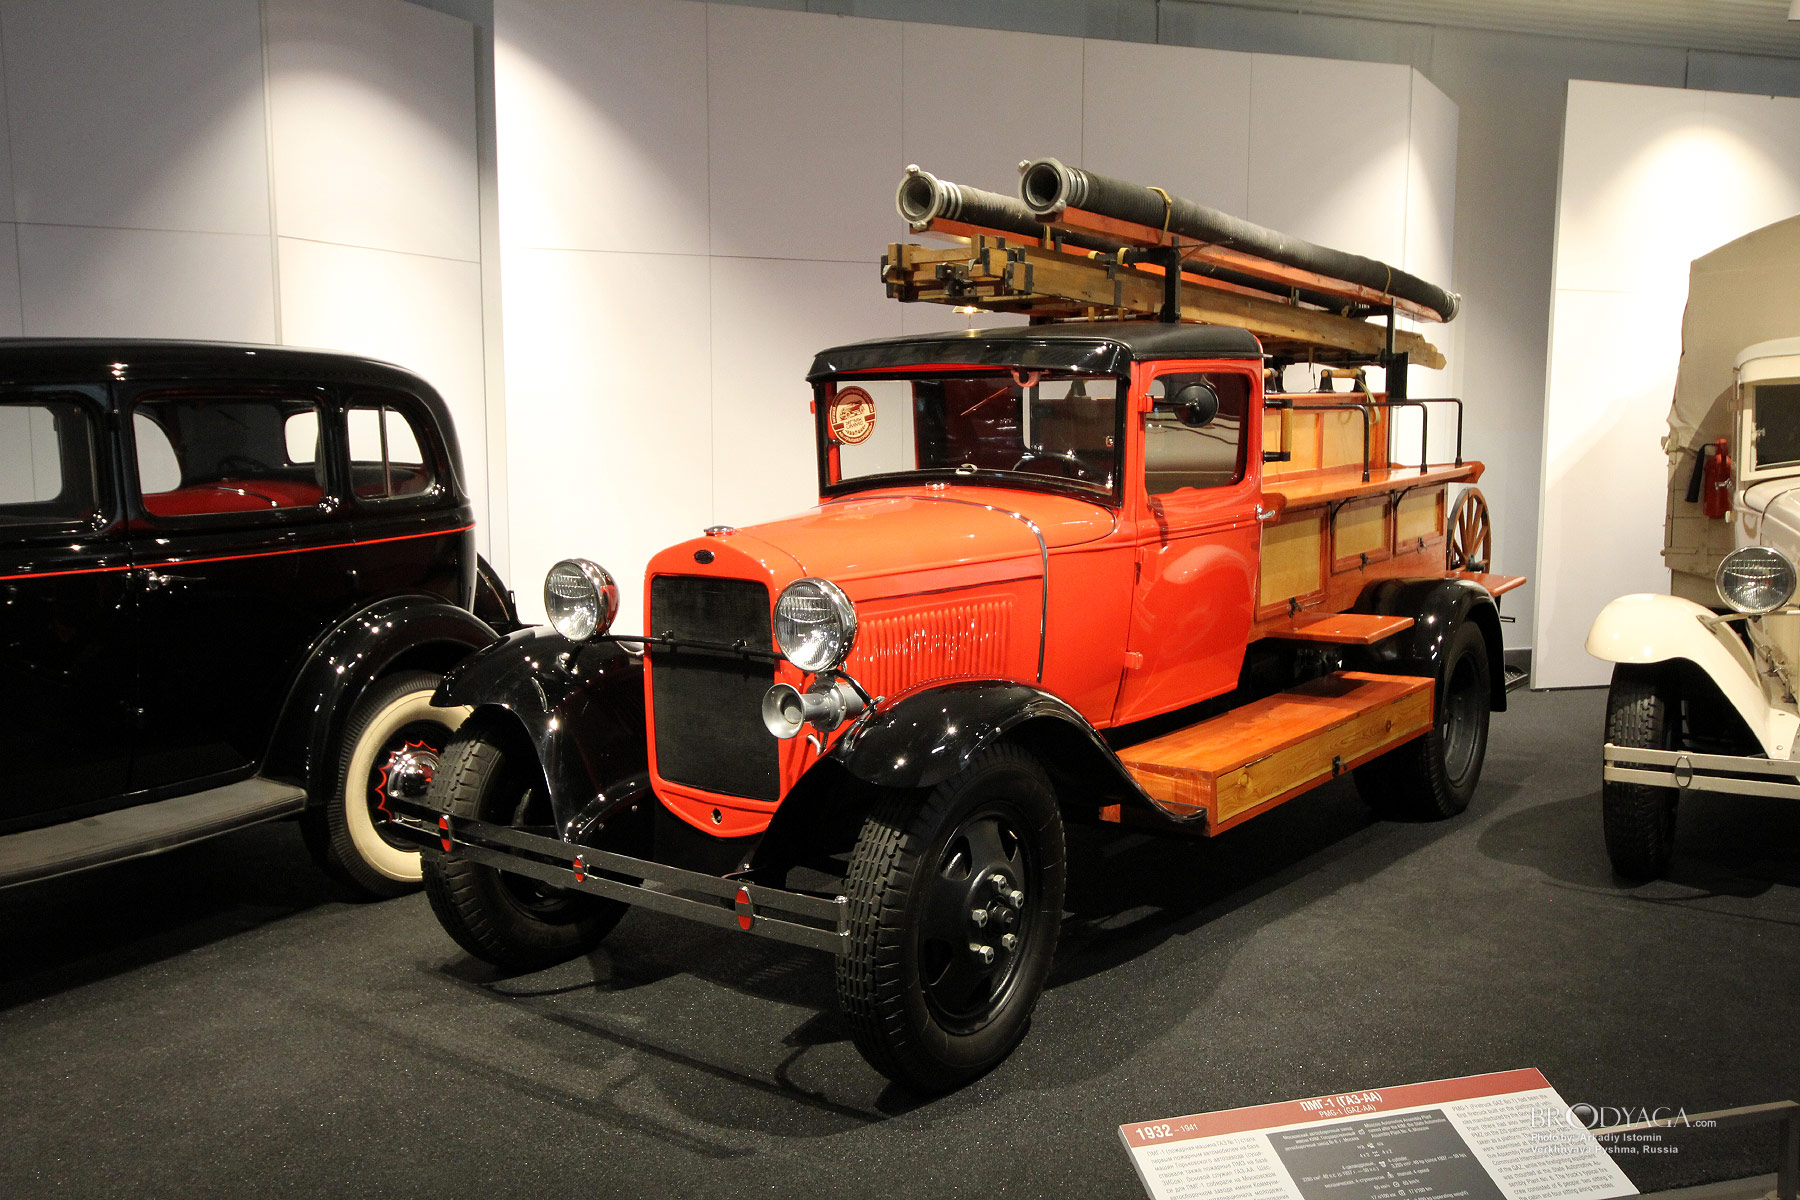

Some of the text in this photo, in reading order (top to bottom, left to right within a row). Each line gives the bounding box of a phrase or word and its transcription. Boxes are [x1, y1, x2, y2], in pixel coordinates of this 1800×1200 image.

[1299, 1092, 1383, 1112] ПМГ-1 (ГАЗ-АА)
[1319, 1104, 1377, 1118] PMG-1 (GAZ-AA)
[1136, 1123, 1173, 1141] 1932
[1180, 1123, 1198, 1133] 1941
[1545, 1157, 1572, 1165] firefighting
[1571, 1153, 1596, 1161] equipment
[1565, 1162, 1593, 1170] Automotive
[1526, 1185, 1551, 1193] consisted
